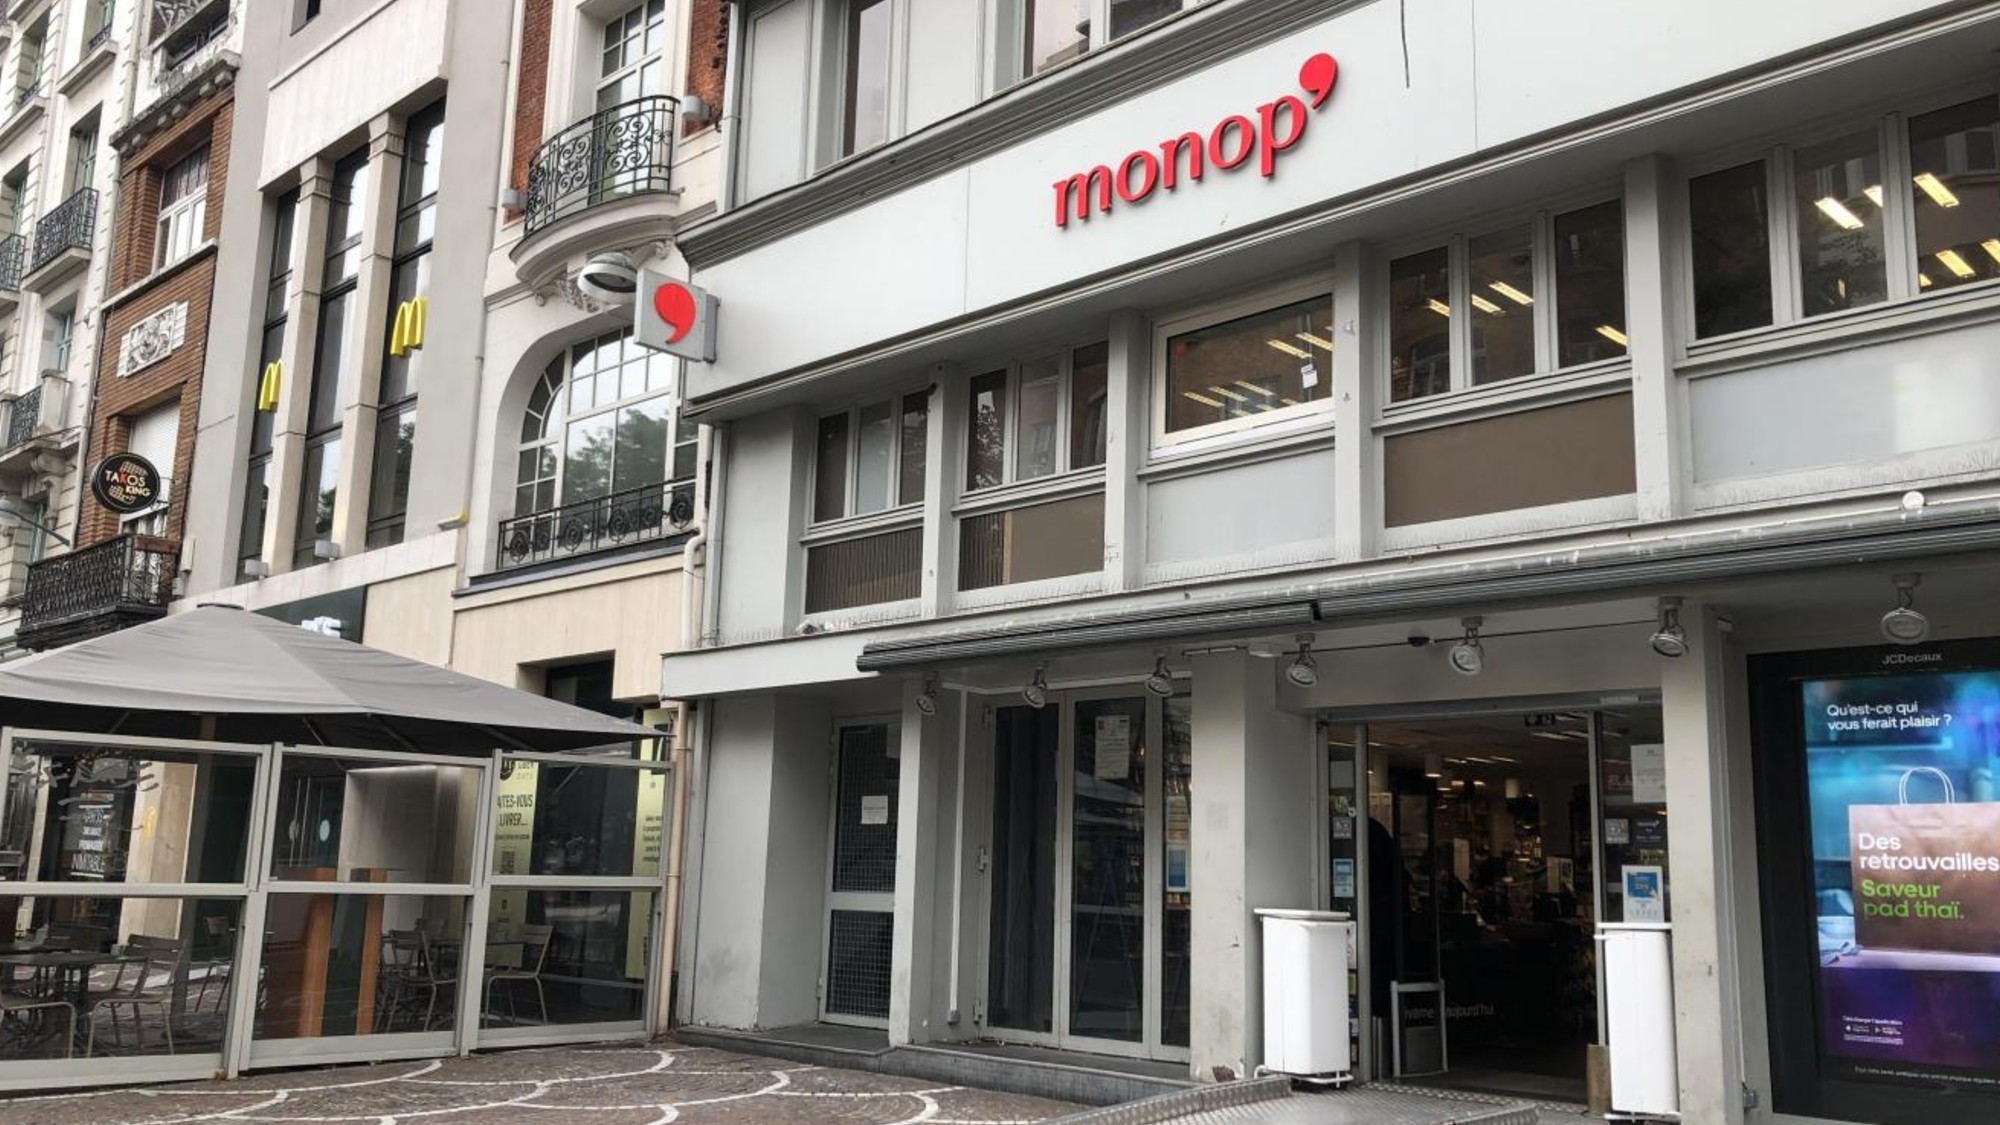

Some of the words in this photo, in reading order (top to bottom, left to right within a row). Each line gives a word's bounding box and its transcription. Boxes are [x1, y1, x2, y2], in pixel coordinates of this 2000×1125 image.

[104, 470, 146, 487] TAKOS
[125, 485, 151, 497] KING
[1882, 653, 1942, 665] JCDecaux
[1827, 703, 1893, 717] Qu'est-ce
[1896, 701, 1918, 715] qui
[1828, 720, 1860, 731] vous
[1862, 718, 1897, 730] ferait
[1900, 714, 1940, 731] plaisir
[1943, 714, 1952, 727] ?
[1858, 832, 1902, 850] Des
[1860, 852, 2000, 871] retrouvailles
[1861, 879, 1940, 898] Saveur
[1864, 900, 1909, 920] pad
[1914, 901, 1965, 919] thaï.
